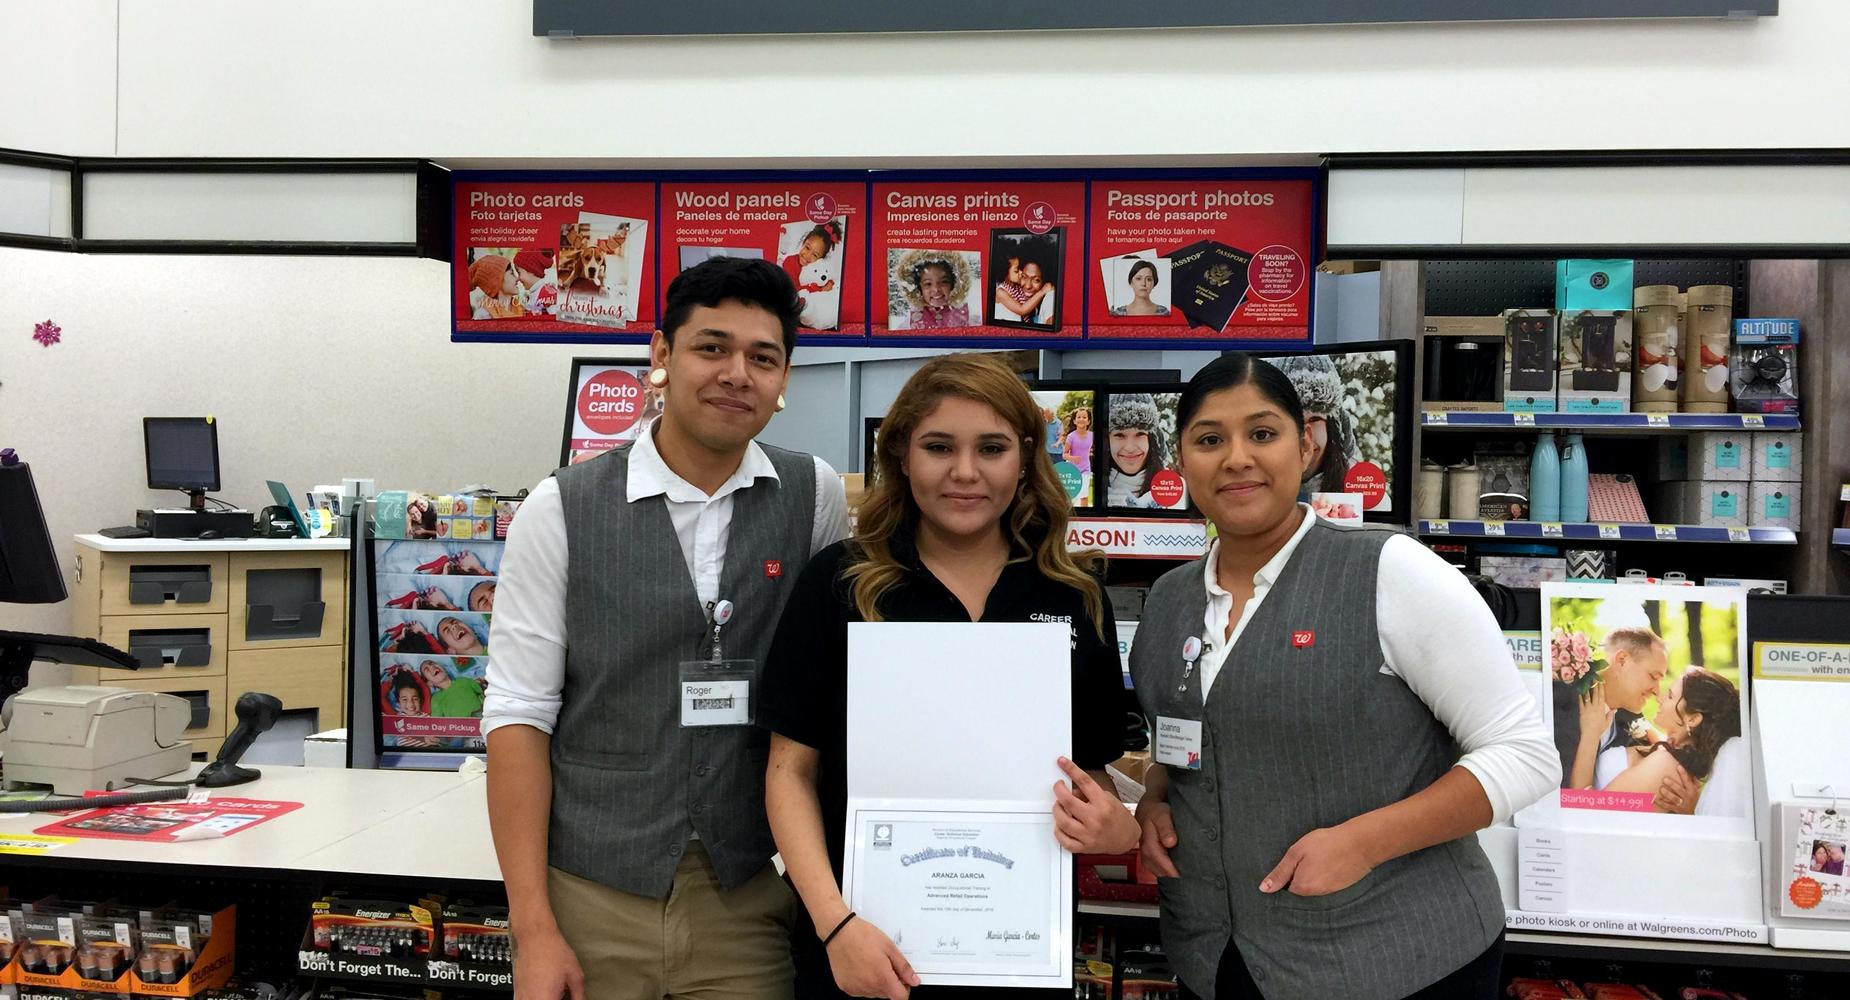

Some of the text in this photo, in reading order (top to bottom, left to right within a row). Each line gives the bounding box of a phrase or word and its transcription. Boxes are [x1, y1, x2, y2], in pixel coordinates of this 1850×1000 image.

[470, 192, 584, 208] Photo cards
[676, 192, 800, 210] Wood panels
[886, 192, 1020, 211] Canvas prints
[1108, 190, 1274, 210] Passport photos
[471, 210, 542, 222] Foto tarjetas
[676, 211, 787, 220] Paneles de madera
[887, 211, 1018, 223] Impresiones en lienzo
[1108, 210, 1228, 222] Fotos de pasaporte
[490, 227, 515, 236] holiday
[912, 229, 938, 237] lasting
[1148, 228, 1172, 237] photo
[1741, 321, 1794, 336] ALTITUDE
[589, 383, 637, 397] Photo
[589, 399, 634, 413] cards
[1030, 613, 1072, 623] CAREER
[1812, 665, 1832, 674] with
[686, 686, 712, 696] Roger
[432, 724, 446, 733] Day
[449, 724, 475, 733] Pickup
[1160, 722, 1180, 733] Joanna
[217, 799, 281, 810] cards
[1562, 794, 1594, 806] Starting
[900, 847, 955, 867] Certificate
[957, 845, 969, 857] of
[356, 909, 391, 919] Energizer
[1515, 915, 1546, 927] photo
[1549, 916, 1576, 927] kiosk
[1593, 919, 1624, 930] online
[1627, 922, 1638, 932] at
[1640, 922, 1758, 939] Walgreens.com/Photo
[191, 953, 232, 984] DURACELL
[300, 959, 421, 978] Don't Forget The...
[25, 975, 60, 985] DURACELL
[429, 968, 512, 986] Don't Forget
[81, 981, 119, 990] DURACELL
[141, 983, 179, 993] DURACELL
